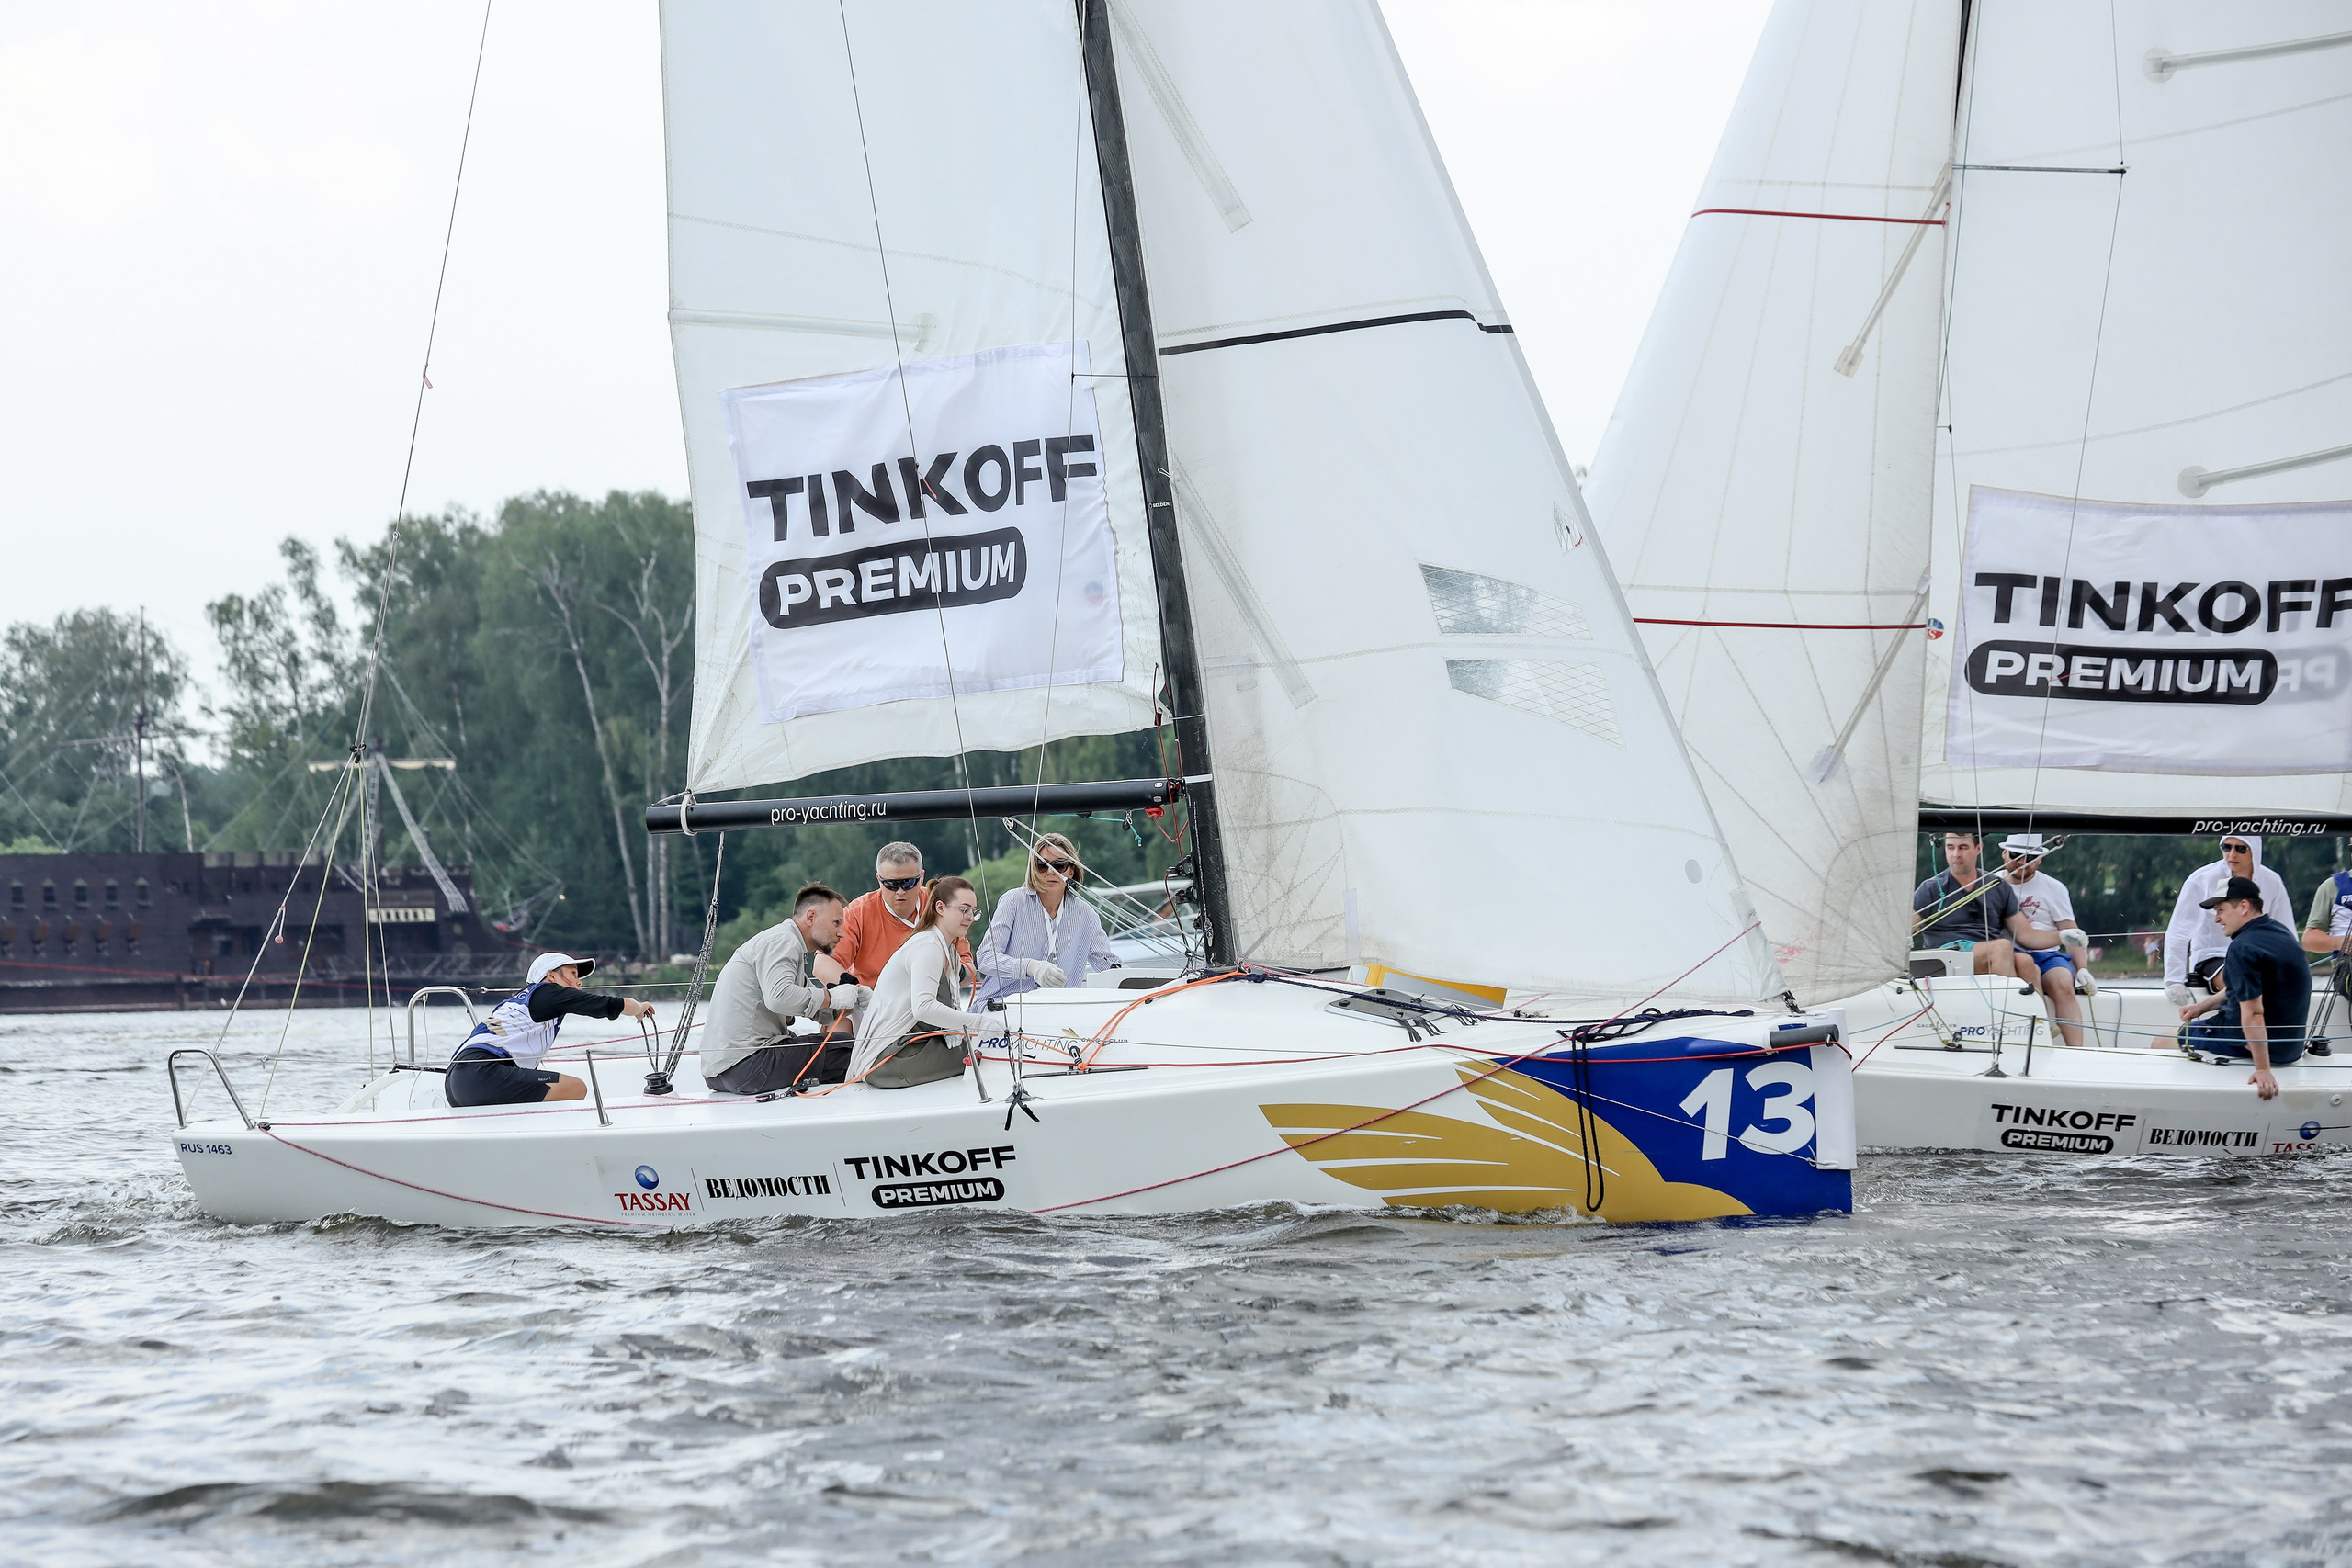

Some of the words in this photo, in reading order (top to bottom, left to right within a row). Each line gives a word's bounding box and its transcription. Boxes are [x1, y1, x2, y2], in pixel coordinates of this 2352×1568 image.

[746, 434, 1098, 542] TINKOFF
[776, 541, 1016, 616] PREMIUM
[1984, 649, 2264, 694] PREMIUM
[770, 799, 888, 825] pro-yachting.ru
[2192, 818, 2326, 836] pro-yachting.ru
[1679, 1061, 1815, 1161] 13
[1991, 1103, 2136, 1133] TINKOFF
[180, 1143, 204, 1154] RUS
[205, 1144, 232, 1156] 1463
[2007, 1131, 2108, 1152] PREMIUM
[2149, 1127, 2259, 1148] ВЕДОМОСТИ
[843, 1145, 1017, 1180] TINKOFF
[705, 1174, 832, 1201] ВЕДОМОСТИ
[879, 1180, 998, 1206] PREMIUM
[614, 1192, 691, 1212] TASSAY
